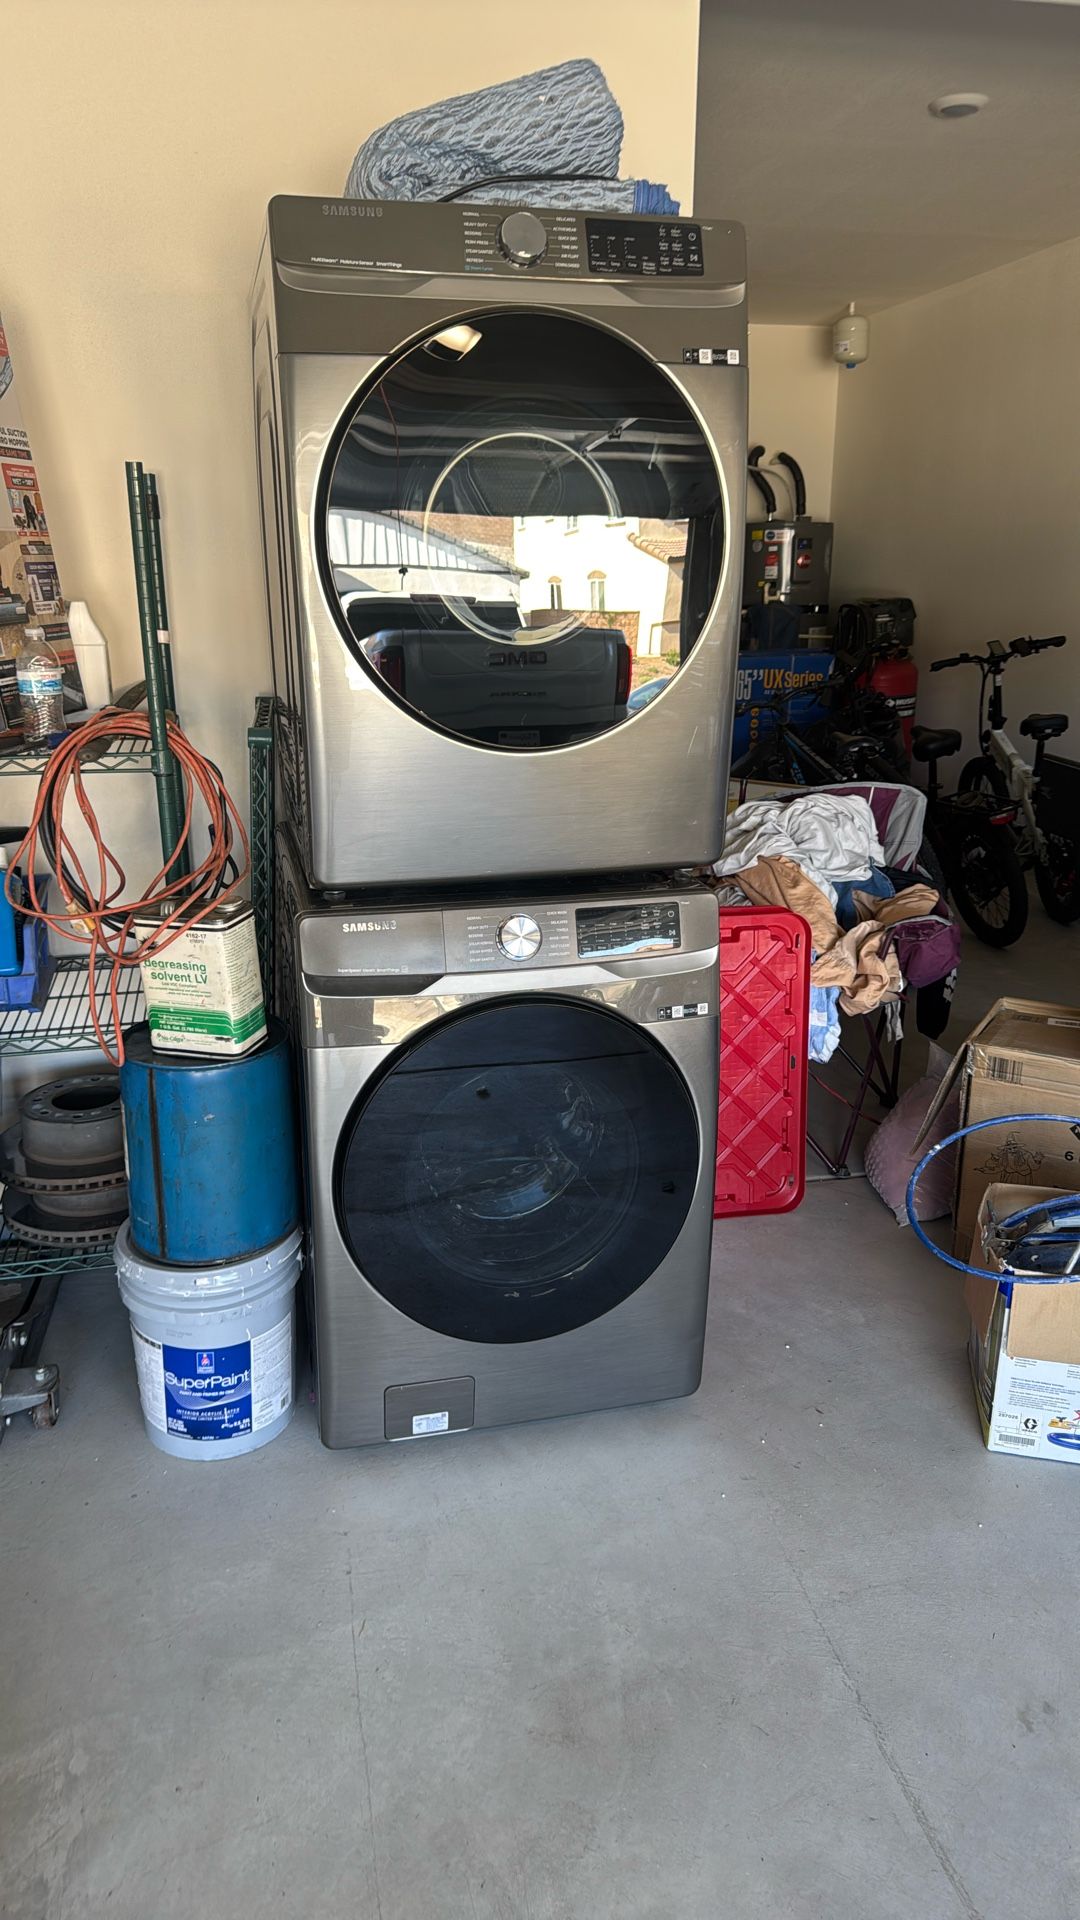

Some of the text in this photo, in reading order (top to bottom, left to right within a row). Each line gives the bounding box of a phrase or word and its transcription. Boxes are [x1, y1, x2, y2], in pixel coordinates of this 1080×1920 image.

[322, 205, 384, 217] SAMSUNG
[764, 669, 785, 689] UX
[342, 920, 397, 933] SAMSUNG
[144, 959, 207, 975] degreasing
[151, 971, 208, 984] solvent LV
[1064, 1150, 1075, 1162] 6
[176, 1407, 200, 1416] INTERIOR
